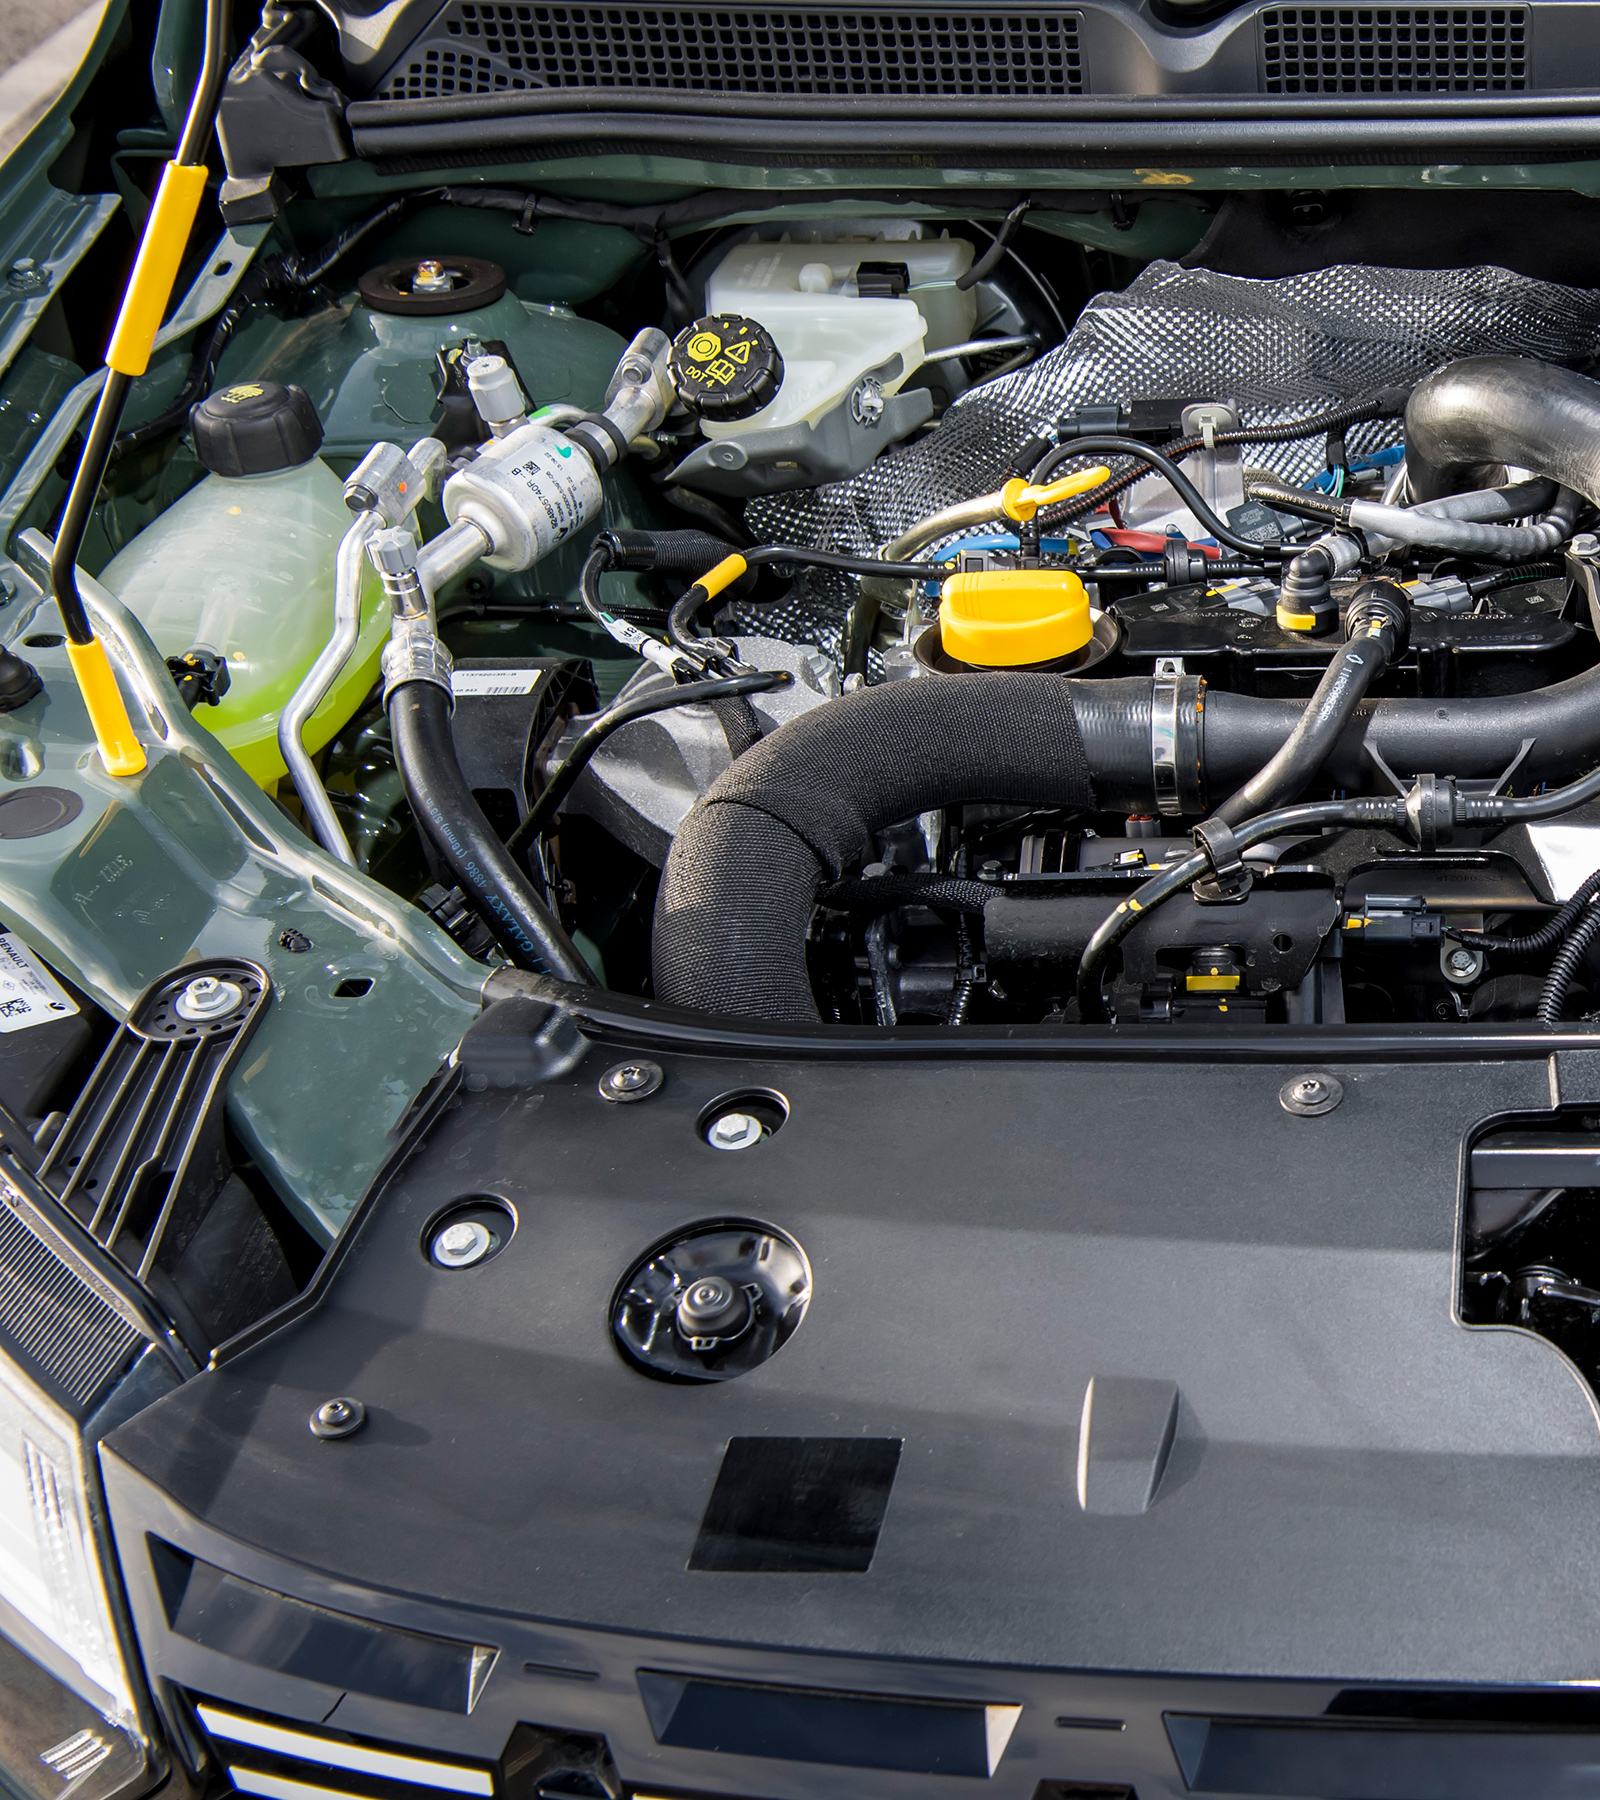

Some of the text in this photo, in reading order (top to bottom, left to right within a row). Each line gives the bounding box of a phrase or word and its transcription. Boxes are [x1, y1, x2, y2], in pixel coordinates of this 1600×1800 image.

[685, 365, 715, 388] DOT 4
[429, 807, 443, 825] 5/8
[440, 823, 468, 859] (16mm)
[464, 861, 488, 889] 4886
[484, 894, 534, 952] GALAXY
